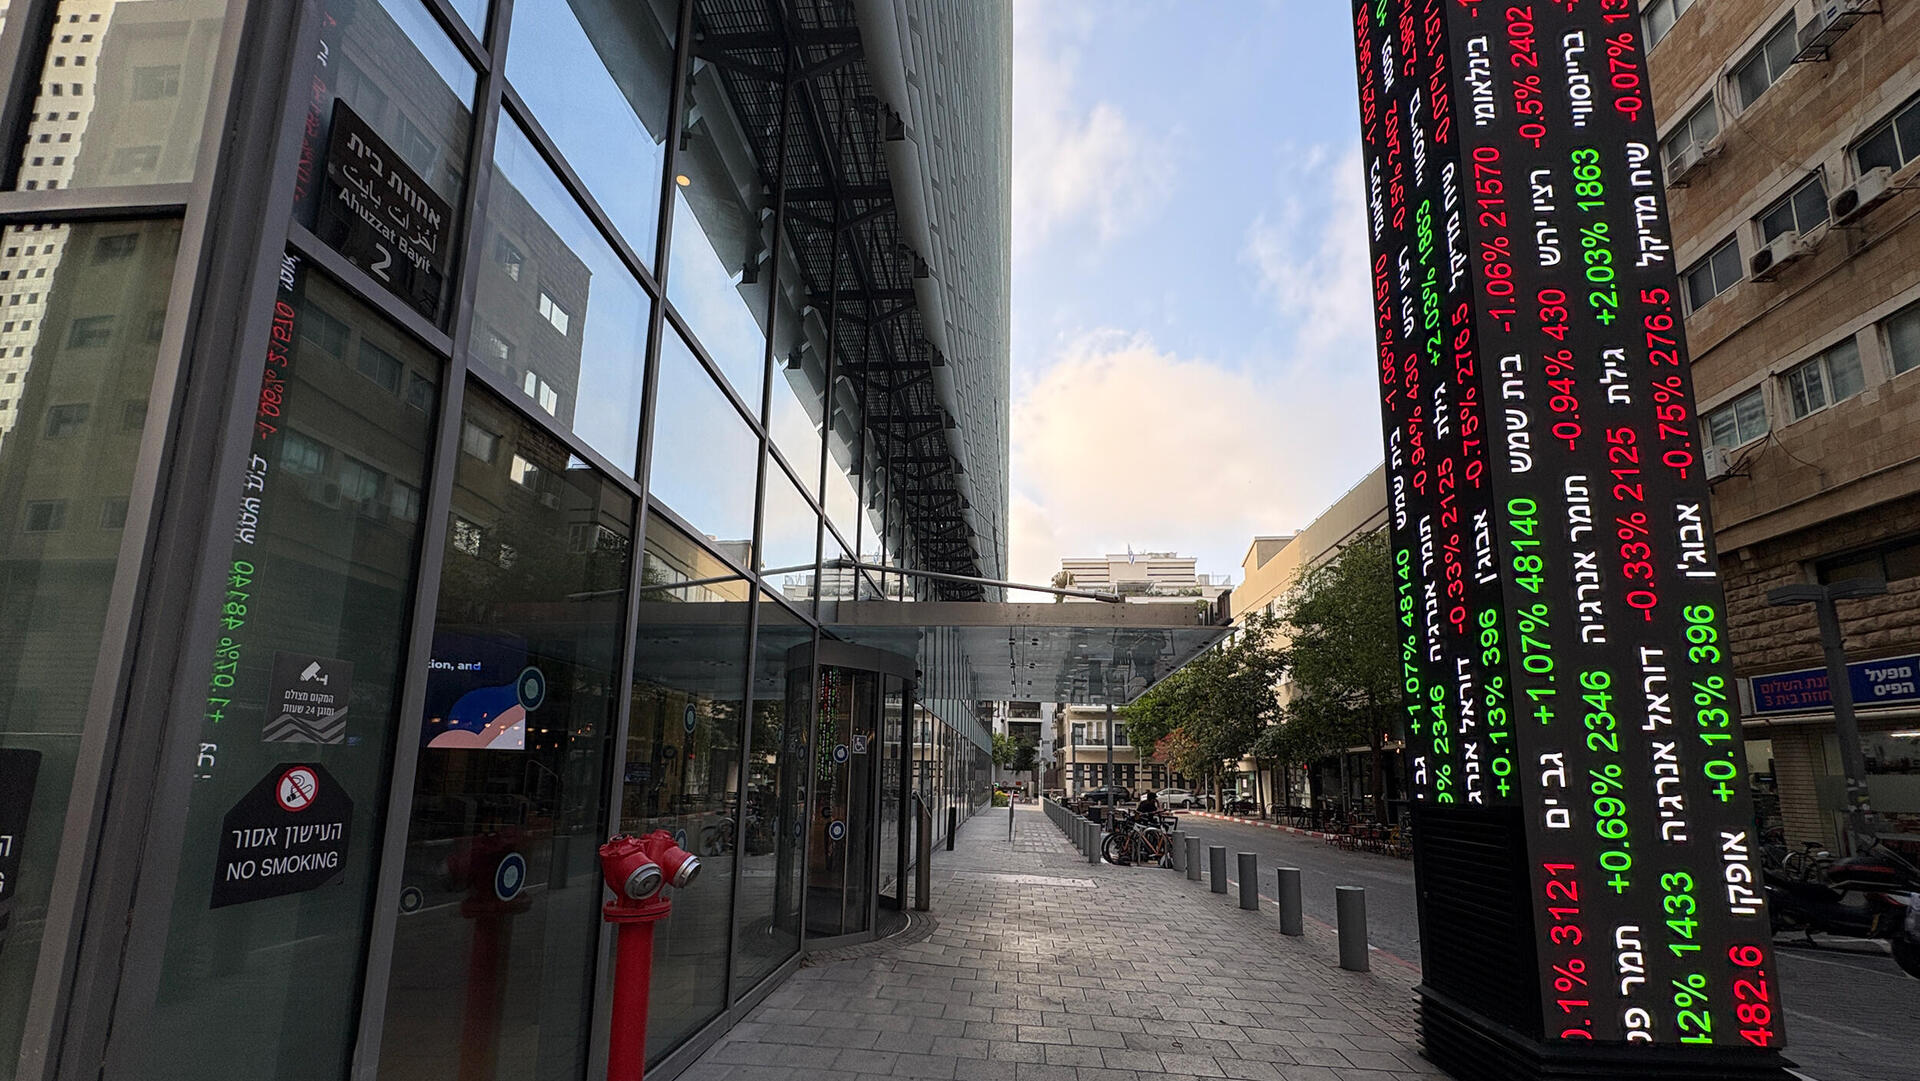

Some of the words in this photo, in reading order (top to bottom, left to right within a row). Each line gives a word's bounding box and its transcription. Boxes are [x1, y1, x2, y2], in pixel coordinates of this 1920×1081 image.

[1505, 6, 1538, 67] 2402
[1429, 54, 1450, 144] -0.07%
[1465, 36, 1495, 126] בינלאומי
[1513, 75, 1547, 148] -0.5%
[1563, 31, 1593, 127] בריינסוויי
[1605, 32, 1643, 122] -0.07%
[347, 132, 384, 178] בית
[1385, 99, 1400, 165] 2402
[1626, 142, 1653, 186] שיח
[343, 164, 382, 209] بايت
[388, 171, 441, 230] אחוזת
[1370, 156, 1384, 241] בינלאומי
[1390, 162, 1405, 230] -0.5%
[1442, 162, 1457, 212] שיח
[1472, 147, 1507, 228] 21570
[1530, 170, 1555, 212] רציו
[1571, 148, 1605, 212] 1863
[338, 187, 396, 245] Ahuzzat
[399, 237, 432, 274] Bayit
[370, 242, 393, 282] 2
[1416, 199, 1433, 265] 1863
[1447, 211, 1467, 293] מדיקל
[1536, 221, 1561, 267] יהש
[1634, 195, 1670, 267] מדיקל
[1375, 253, 1391, 328] 21570
[1399, 245, 1411, 290] רציו
[1481, 237, 1516, 332] -1.06%
[1580, 222, 1618, 325] +2.03%
[1401, 296, 1414, 338] יהש
[1420, 267, 1442, 366] +2.03%
[1452, 303, 1473, 384] 276.5
[1538, 289, 1569, 341] 430
[1640, 288, 1679, 366] 276.5
[1380, 329, 1398, 411] -1.06%
[1404, 353, 1419, 399] 430
[1500, 354, 1525, 400] בית
[1543, 349, 1582, 450] -0.94%
[1600, 348, 1631, 404] גילת
[1433, 382, 1449, 440] גילת
[1459, 386, 1483, 488] -0.75%
[1505, 409, 1533, 473] שמש
[1651, 376, 1693, 480] -0.75%
[1390, 426, 1402, 470] בית
[1408, 405, 1427, 495] -0.94%
[1607, 427, 1644, 502] 2125
[1393, 475, 1407, 531] שמש
[1437, 457, 1457, 528] 2125
[1565, 475, 1593, 542] תומר
[1420, 515, 1433, 576] תומר
[1474, 509, 1498, 584] אבוג'ן
[1507, 498, 1545, 594] 48140
[1615, 511, 1658, 622] -0.33%
[1676, 503, 1717, 577] אבוג'ן
[1396, 549, 1414, 627] 48140
[1443, 534, 1466, 634] -0.33%
[1573, 551, 1606, 643] אנרגיה
[1424, 580, 1441, 662] אנרגיה
[1479, 608, 1501, 667] 396
[1683, 605, 1721, 664] 396
[284, 689, 308, 700] מצולם
[310, 693, 334, 704] המקום
[457, 661, 481, 670] and
[1403, 635, 1421, 734] +1.07%
[1457, 658, 1475, 733] דוראל
[1518, 603, 1556, 725] +1.07%
[1640, 646, 1673, 731] דוראל
[1760, 679, 1804, 695] השלום
[1775, 692, 1799, 706] בית
[1865, 666, 1912, 681] מפעל
[1874, 682, 1915, 696] הפיס
[282, 703, 304, 714] שעות
[305, 704, 315, 714] 24
[1430, 685, 1449, 754] 2346
[1580, 670, 1619, 752] 2346
[1764, 694, 1774, 706] 3
[1414, 756, 1427, 785] גב
[1484, 676, 1511, 797] +0.13%
[1540, 752, 1566, 787] גב
[1692, 675, 1737, 802] +0.13%
[1544, 799, 1570, 828] ים
[1652, 741, 1688, 841] אנרגיה
[232, 827, 278, 849] אסור
[284, 822, 343, 849] העישון
[1588, 764, 1632, 894] +0.69%
[226, 860, 256, 881] NO
[260, 851, 338, 877] SMOKING
[1720, 831, 1763, 914] אופקו
[1544, 863, 1583, 945] 3121
[1661, 872, 1701, 958] 1433
[1615, 925, 1645, 996] תמר
[1728, 945, 1774, 1047] 482.6
